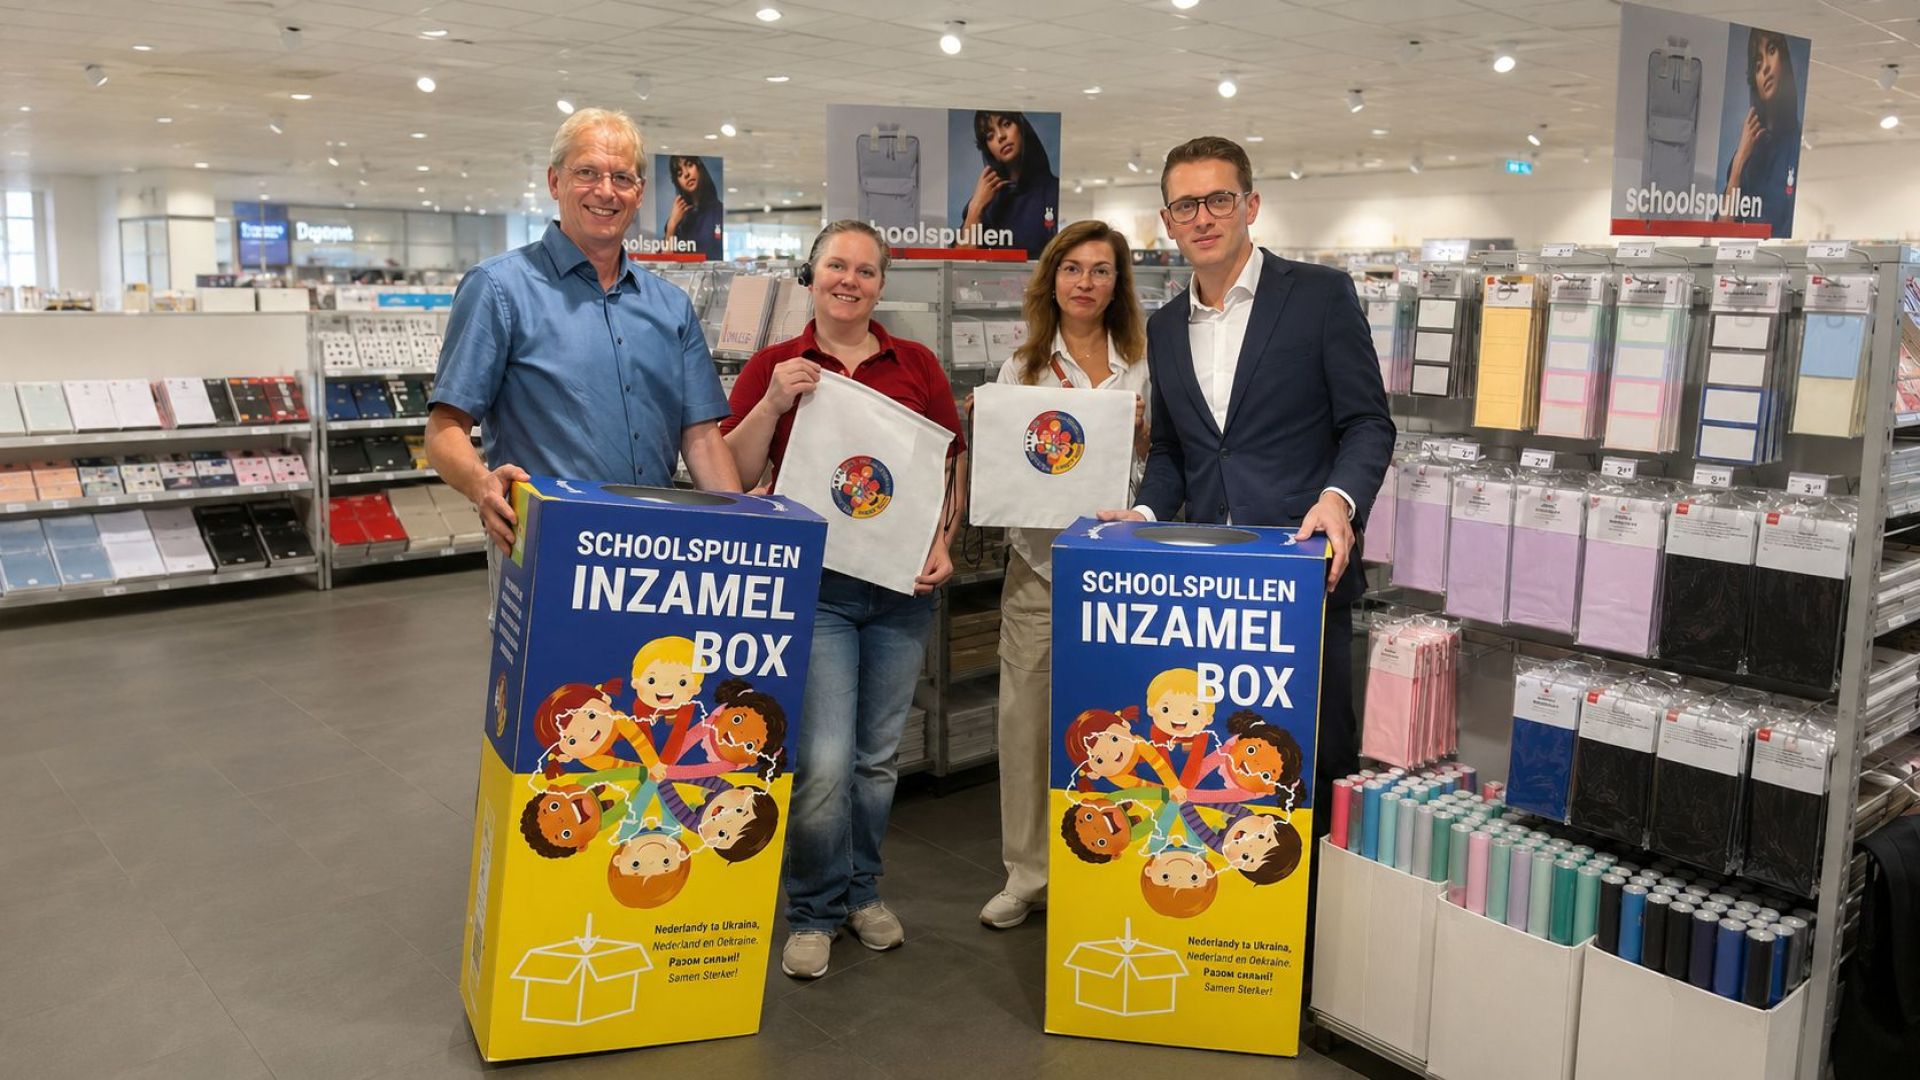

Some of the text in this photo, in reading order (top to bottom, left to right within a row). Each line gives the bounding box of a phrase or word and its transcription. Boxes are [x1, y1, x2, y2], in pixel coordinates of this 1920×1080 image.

[1626, 182, 1764, 222] schoolspullen
[577, 530, 801, 569] SCHOOLSPULLEN
[571, 565, 795, 620] INZAMEL
[1081, 570, 1296, 602] SCHOOLSPULLEN
[1081, 601, 1296, 654] INZAMEL
[691, 631, 792, 677] BOX
[1196, 662, 1295, 709] BOX
[703, 940, 714, 948] en
[1235, 956, 1247, 965] en
[668, 972, 700, 984] Samen
[1204, 982, 1235, 993] Samen
